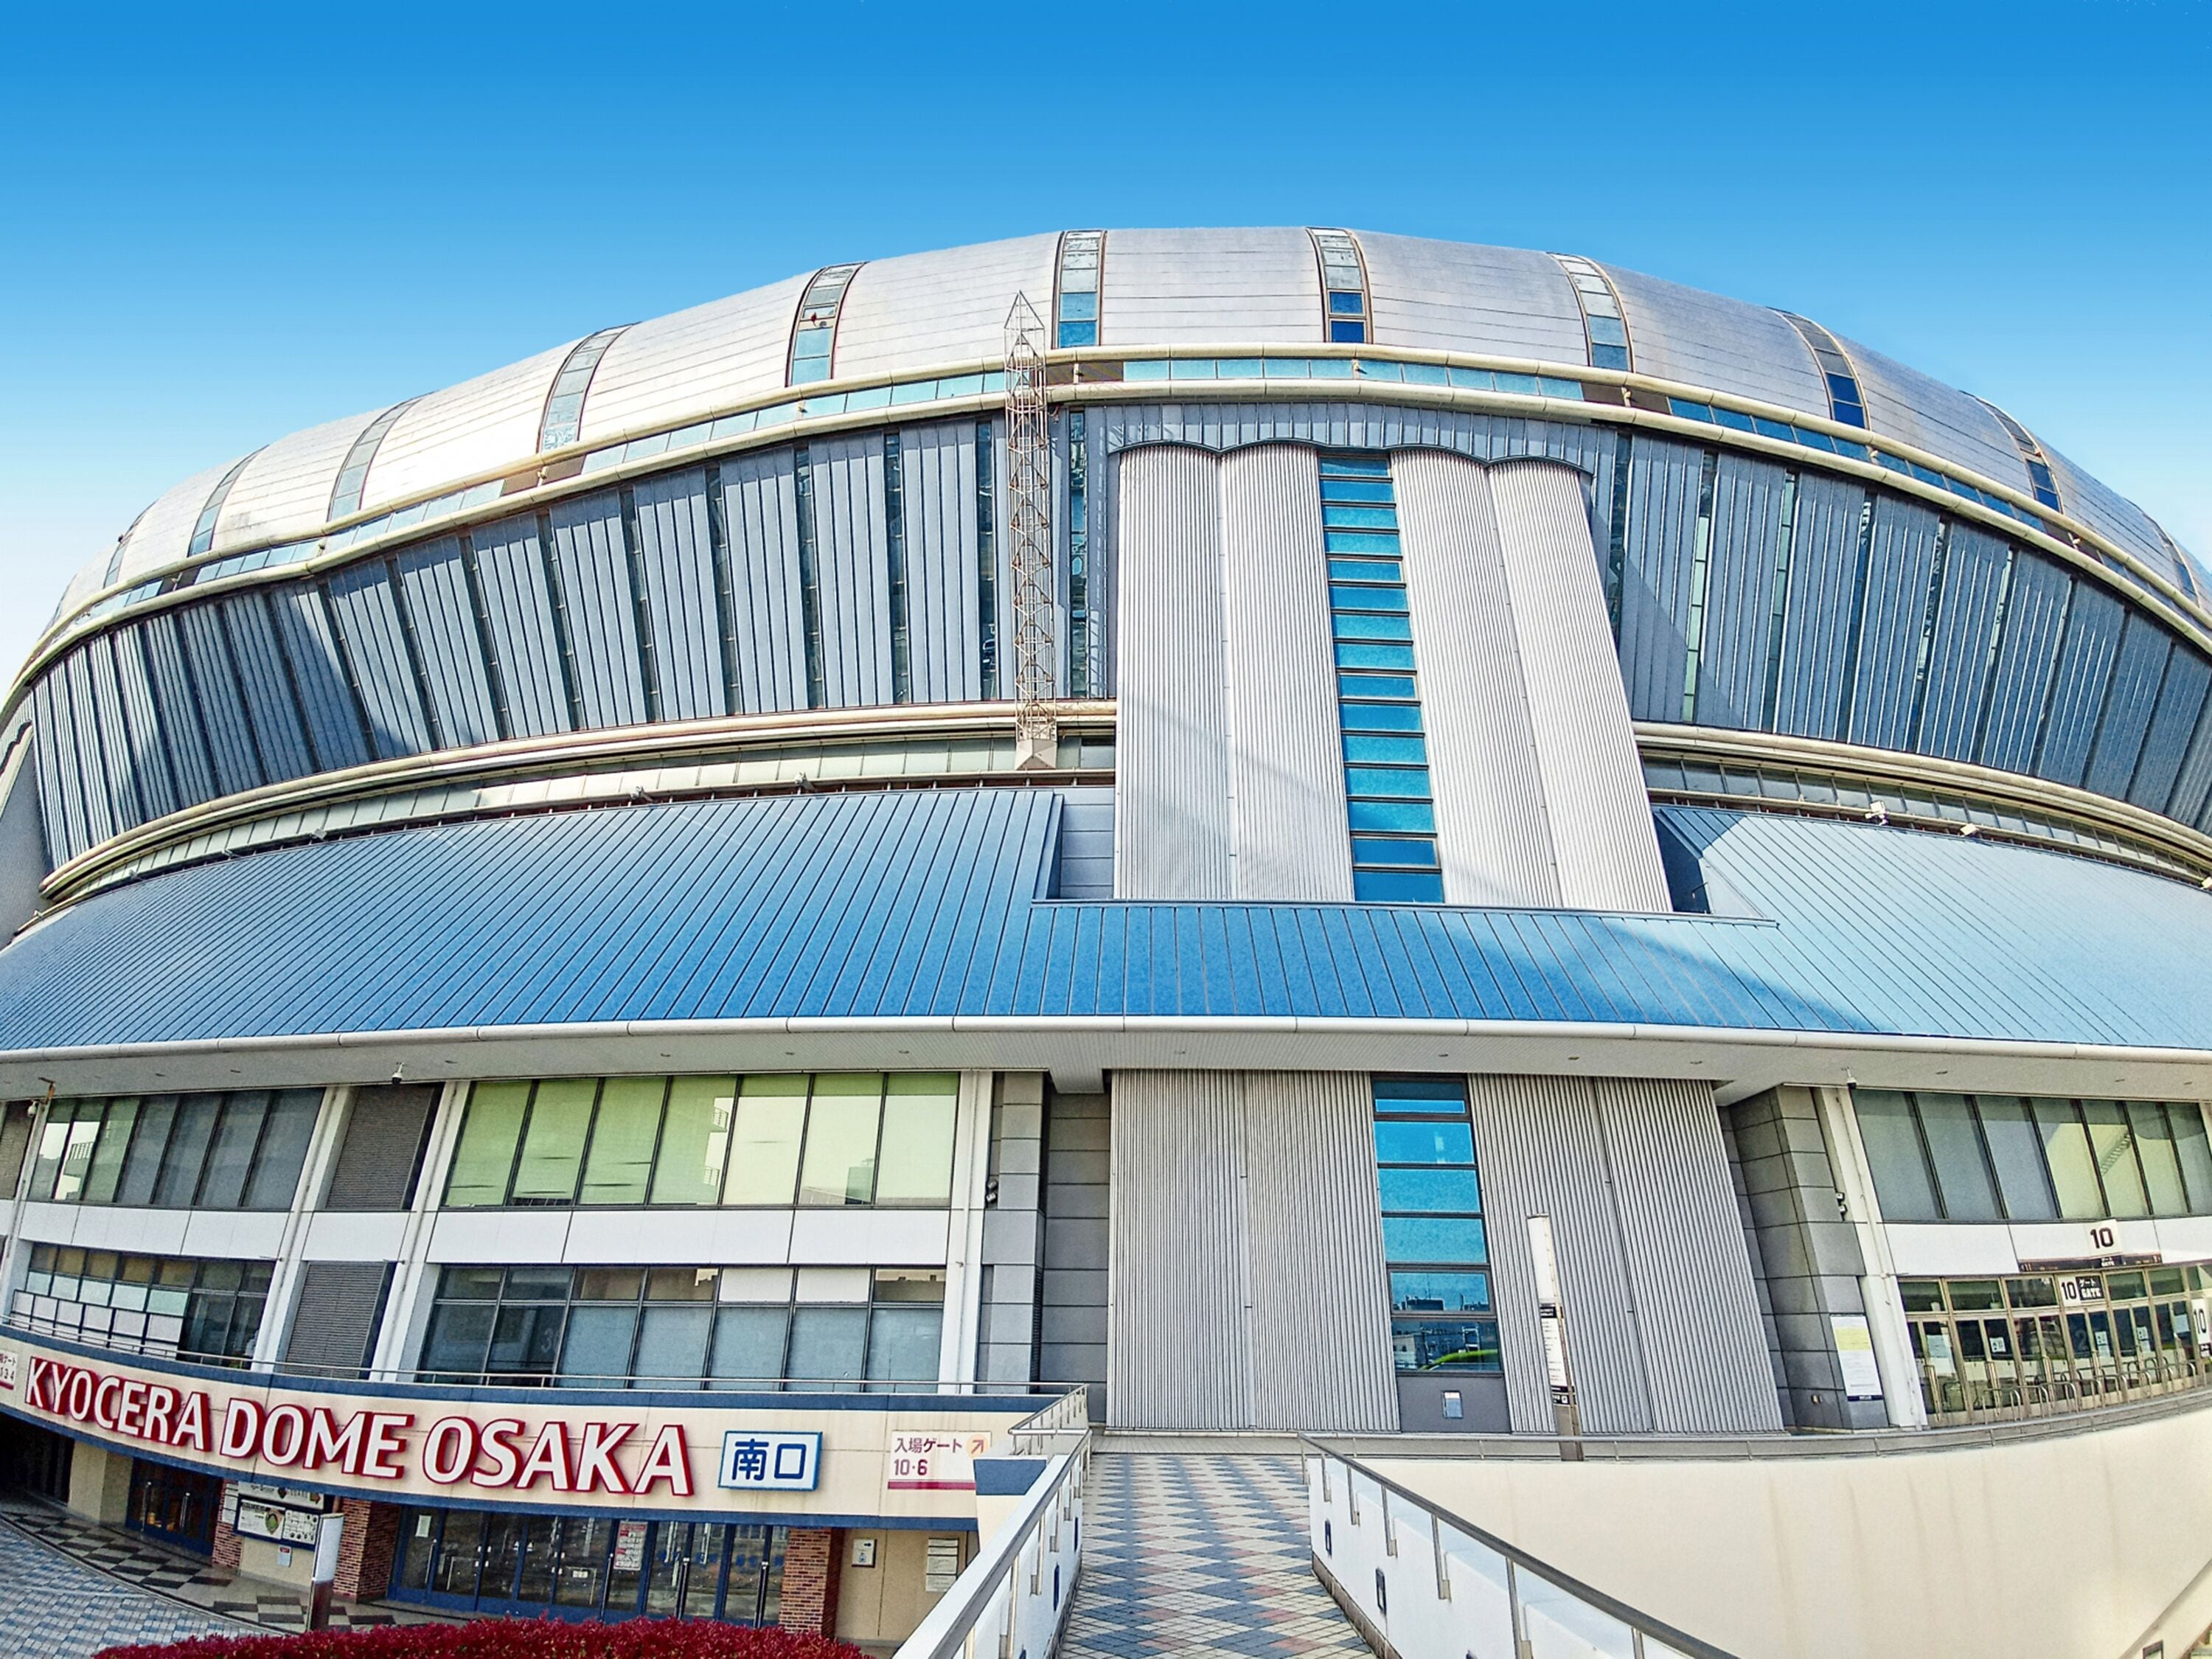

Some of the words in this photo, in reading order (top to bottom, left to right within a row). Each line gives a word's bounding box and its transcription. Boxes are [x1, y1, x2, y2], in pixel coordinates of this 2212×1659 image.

[2090, 1227, 2114, 1248] 10
[2062, 1281, 2076, 1300] 10
[2079, 1279, 2096, 1287] ゲート
[2081, 1287, 2101, 1298] GATE
[2194, 1309, 2206, 1334] 10
[26, 1357, 212, 1452] KYOCERA
[220, 1397, 414, 1478] DOME
[422, 1416, 695, 1496] OSAKA
[894, 1437, 962, 1453] 入場ゲート
[732, 1439, 807, 1481] 南口
